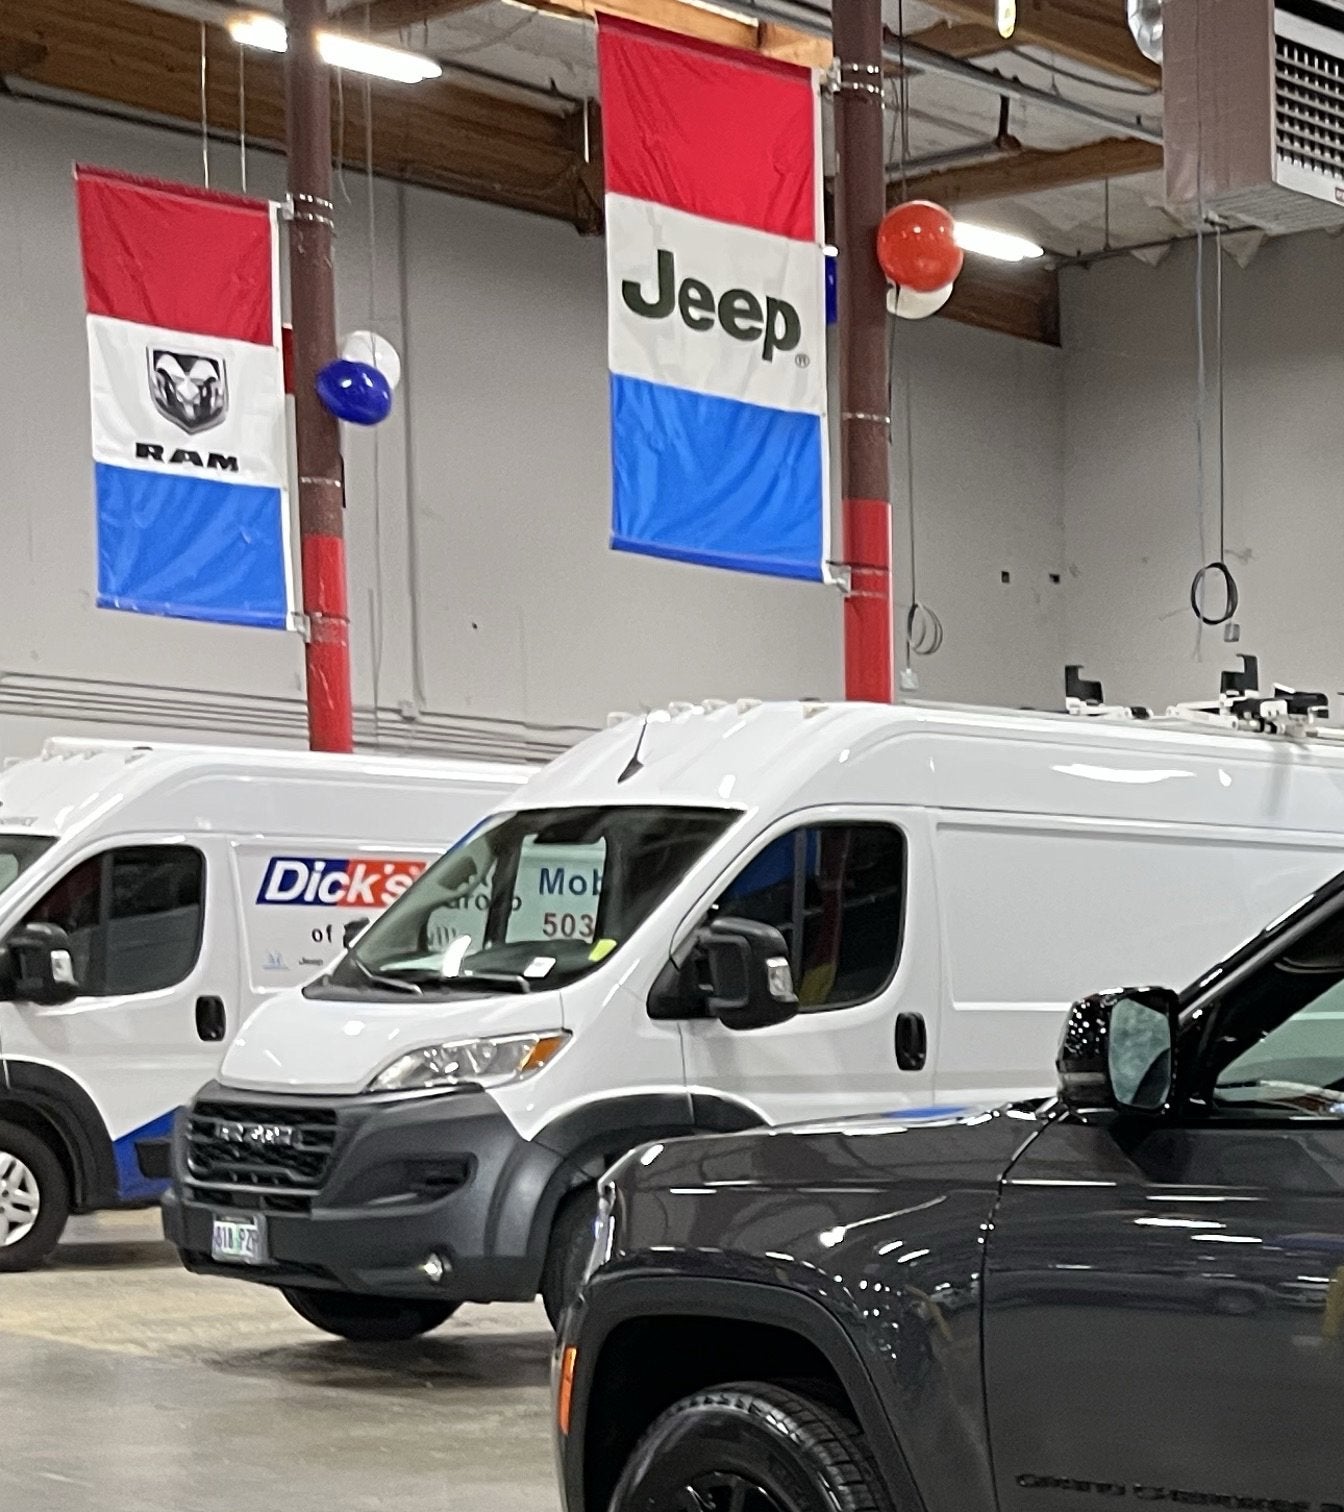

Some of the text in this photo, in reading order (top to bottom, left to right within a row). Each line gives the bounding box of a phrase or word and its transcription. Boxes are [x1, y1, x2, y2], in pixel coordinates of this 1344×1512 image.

[621, 249, 802, 363] Jeep
[136, 442, 239, 473] RAM
[311, 924, 333, 943] of
[542, 913, 594, 938] 503
